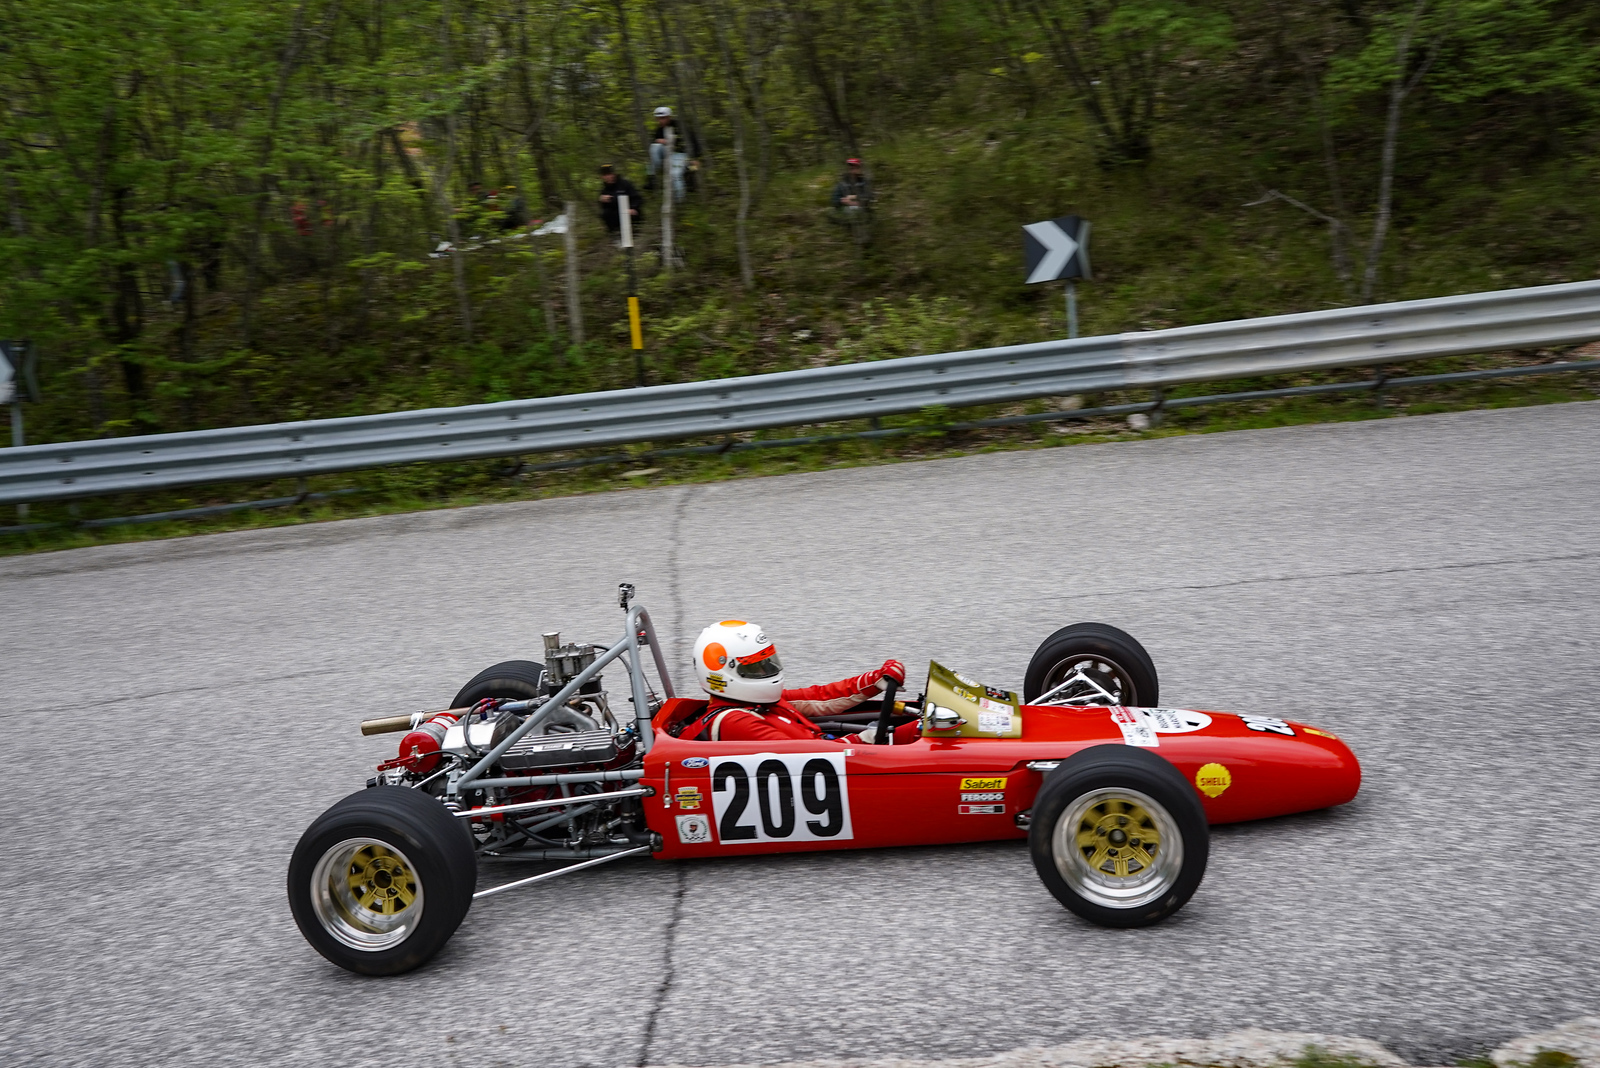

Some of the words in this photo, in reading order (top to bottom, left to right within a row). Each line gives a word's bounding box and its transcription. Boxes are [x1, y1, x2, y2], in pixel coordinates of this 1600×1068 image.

[684, 758, 706, 767] Ford
[963, 779, 1002, 789] Sabelt
[1200, 777, 1227, 786] SHELL
[713, 758, 844, 840] 209
[961, 793, 1004, 801] FERODO
